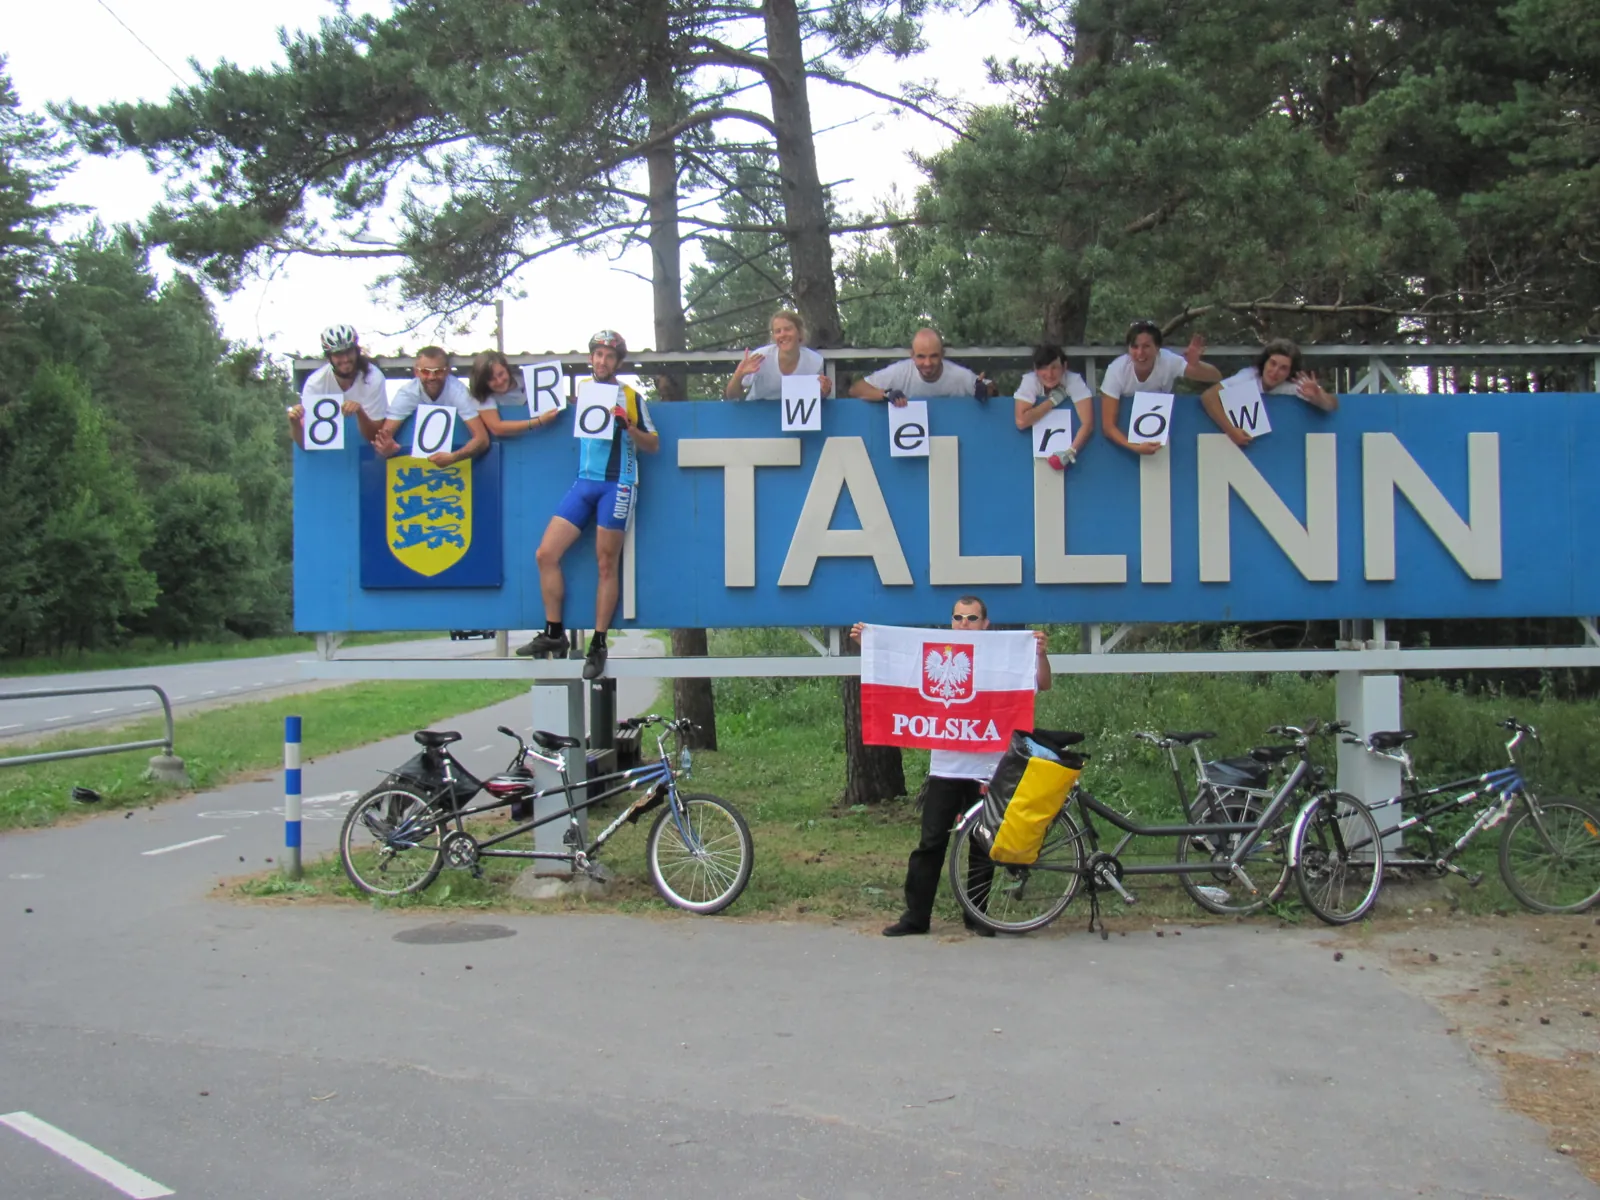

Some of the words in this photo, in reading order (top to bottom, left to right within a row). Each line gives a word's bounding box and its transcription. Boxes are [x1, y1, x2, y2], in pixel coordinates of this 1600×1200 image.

[532, 365, 561, 412] R
[308, 398, 341, 446] 8
[893, 422, 926, 451] e
[1038, 428, 1066, 453] r
[677, 432, 1502, 588] TALLINN
[891, 713, 1002, 741] POLSKA
